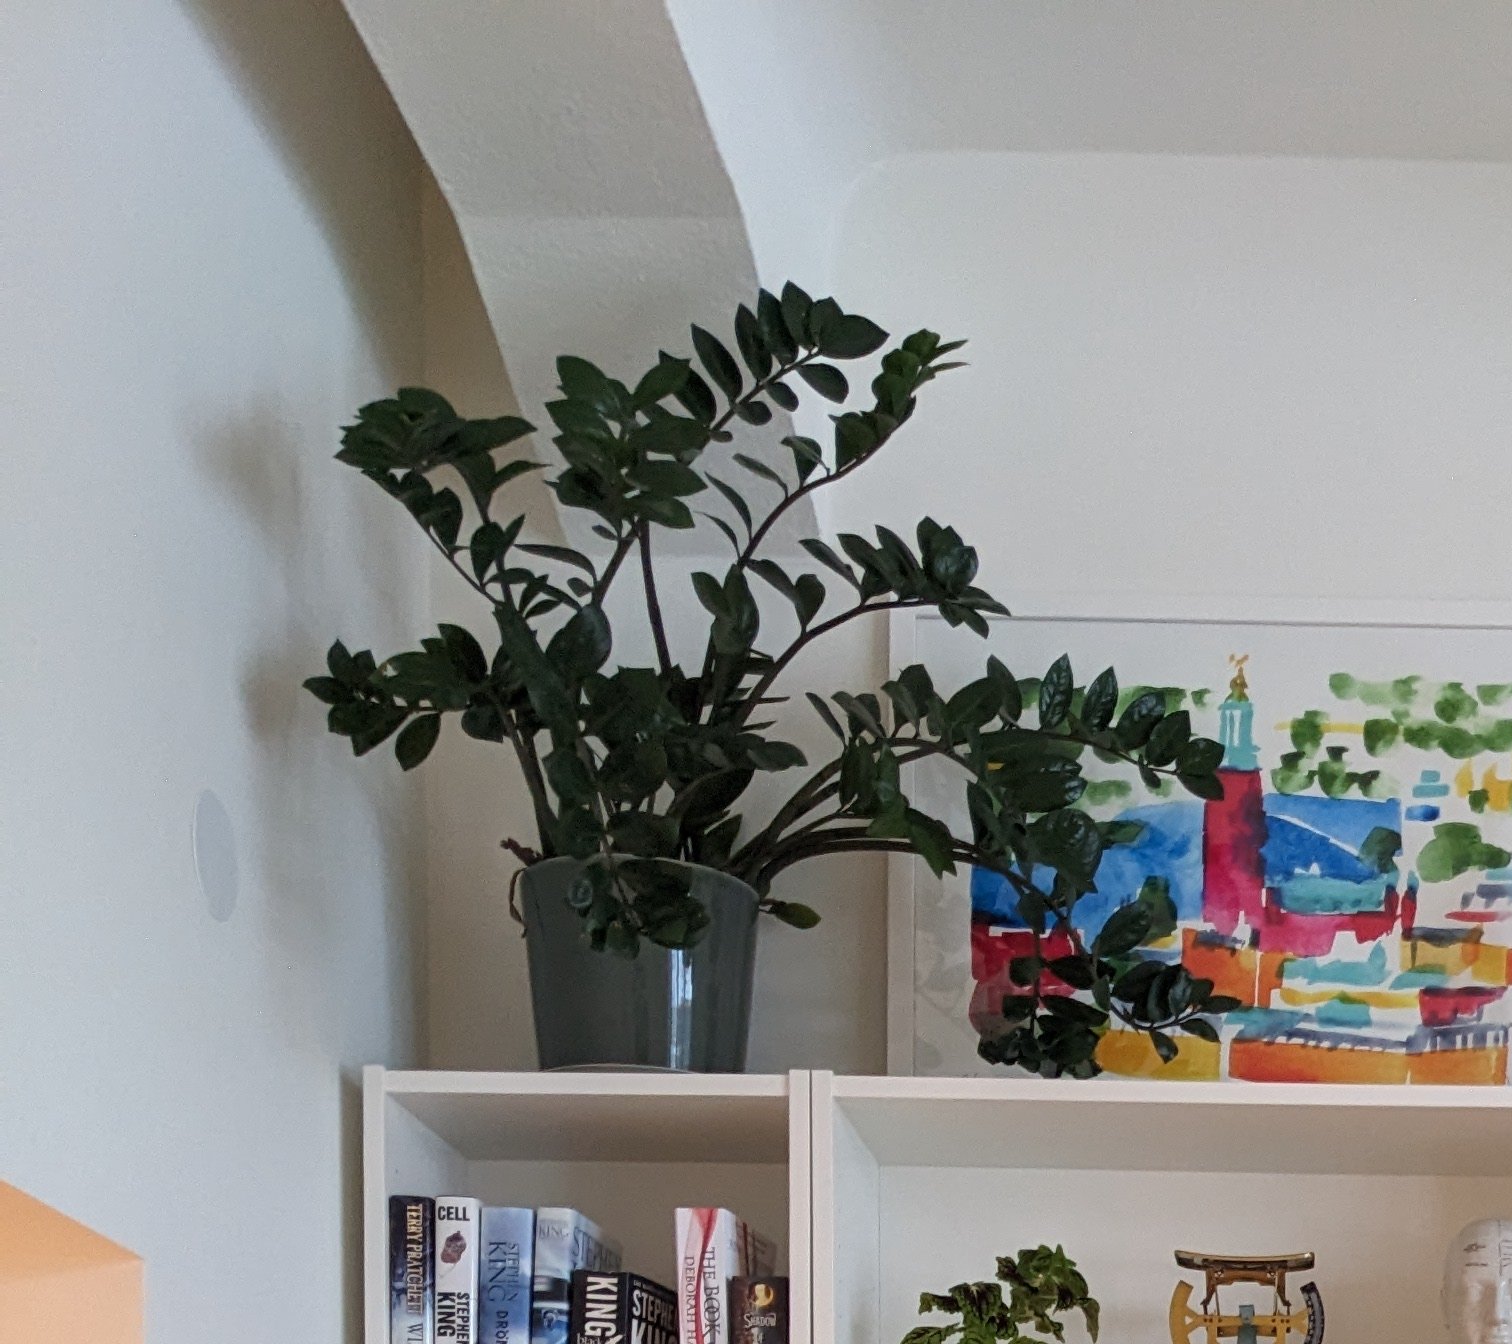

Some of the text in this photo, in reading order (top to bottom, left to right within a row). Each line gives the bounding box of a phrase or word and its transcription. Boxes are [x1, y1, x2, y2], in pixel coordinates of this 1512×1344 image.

[437, 1206, 471, 1221] CELL
[488, 1241, 507, 1302] KING
[437, 1291, 456, 1337] KING
[584, 1276, 619, 1337] KING
